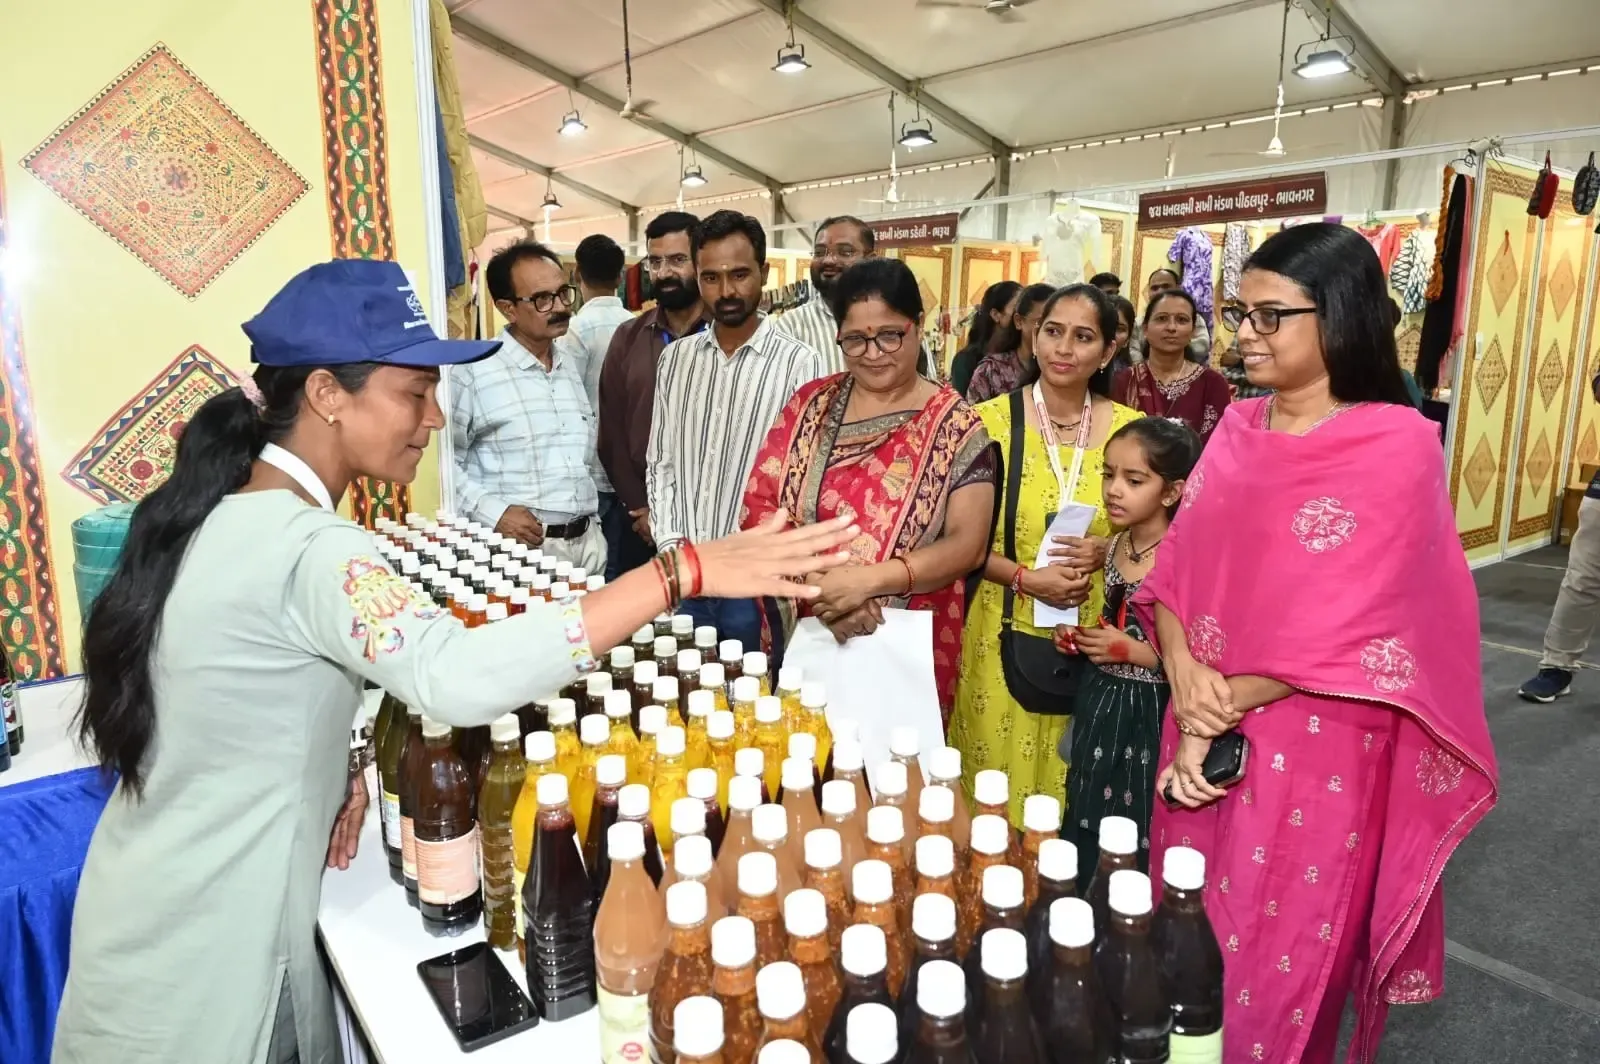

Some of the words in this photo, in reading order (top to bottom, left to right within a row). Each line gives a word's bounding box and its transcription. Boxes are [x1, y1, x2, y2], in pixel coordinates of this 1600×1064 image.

[1149, 206, 1161, 218] જય
[1195, 194, 1212, 213] સખી
[1214, 198, 1233, 213] મંડળ
[1276, 188, 1315, 206] ભાવનગર
[879, 226, 893, 241] સખી
